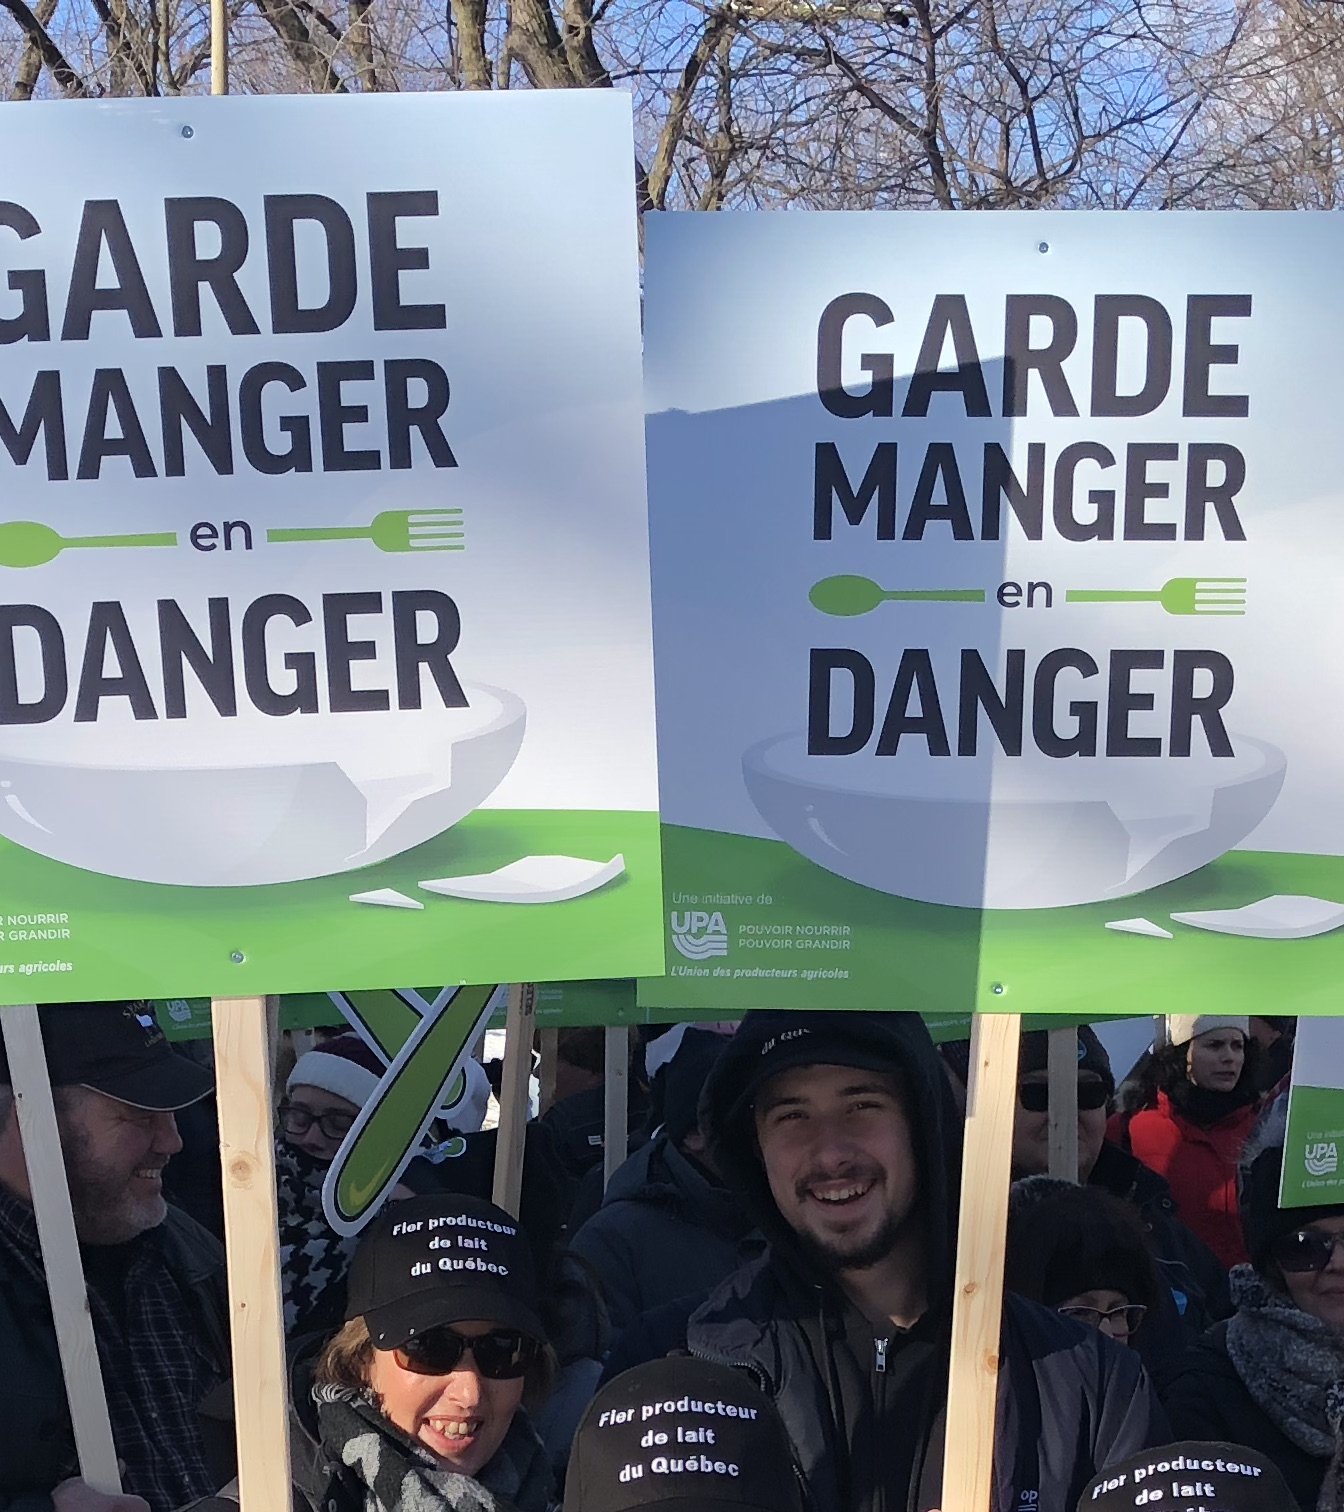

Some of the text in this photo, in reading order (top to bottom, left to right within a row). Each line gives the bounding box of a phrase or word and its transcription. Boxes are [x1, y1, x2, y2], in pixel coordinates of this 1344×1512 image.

[816, 292, 1253, 419] GARDE
[812, 441, 1248, 543] MANGER
[189, 515, 254, 554] en
[996, 574, 1053, 609] en
[806, 647, 1235, 758] DANGER
[672, 892, 773, 905] Une initiative de
[7, 913, 69, 926] NOURRIR
[670, 911, 728, 934] UPA
[739, 925, 851, 936] POUVOIR NOURRIR
[8, 928, 71, 941] GRANDIR
[739, 938, 851, 949] POUVOIR GRANDIR
[18, 960, 73, 975] agricoles
[712, 966, 731, 977] des
[733, 967, 798, 979] producteurs
[800, 968, 849, 980] agricoles
[1305, 1142, 1337, 1159] UPA
[392, 1214, 517, 1236] Fier producteur
[429, 1235, 488, 1251] de lait
[410, 1256, 509, 1277] du Québec
[598, 1396, 757, 1428] Fier producteur
[640, 1426, 716, 1448] de lait
[618, 1455, 740, 1483] du Québec
[1091, 1455, 1262, 1500] Fier producteur
[1134, 1481, 1216, 1506] de lait
